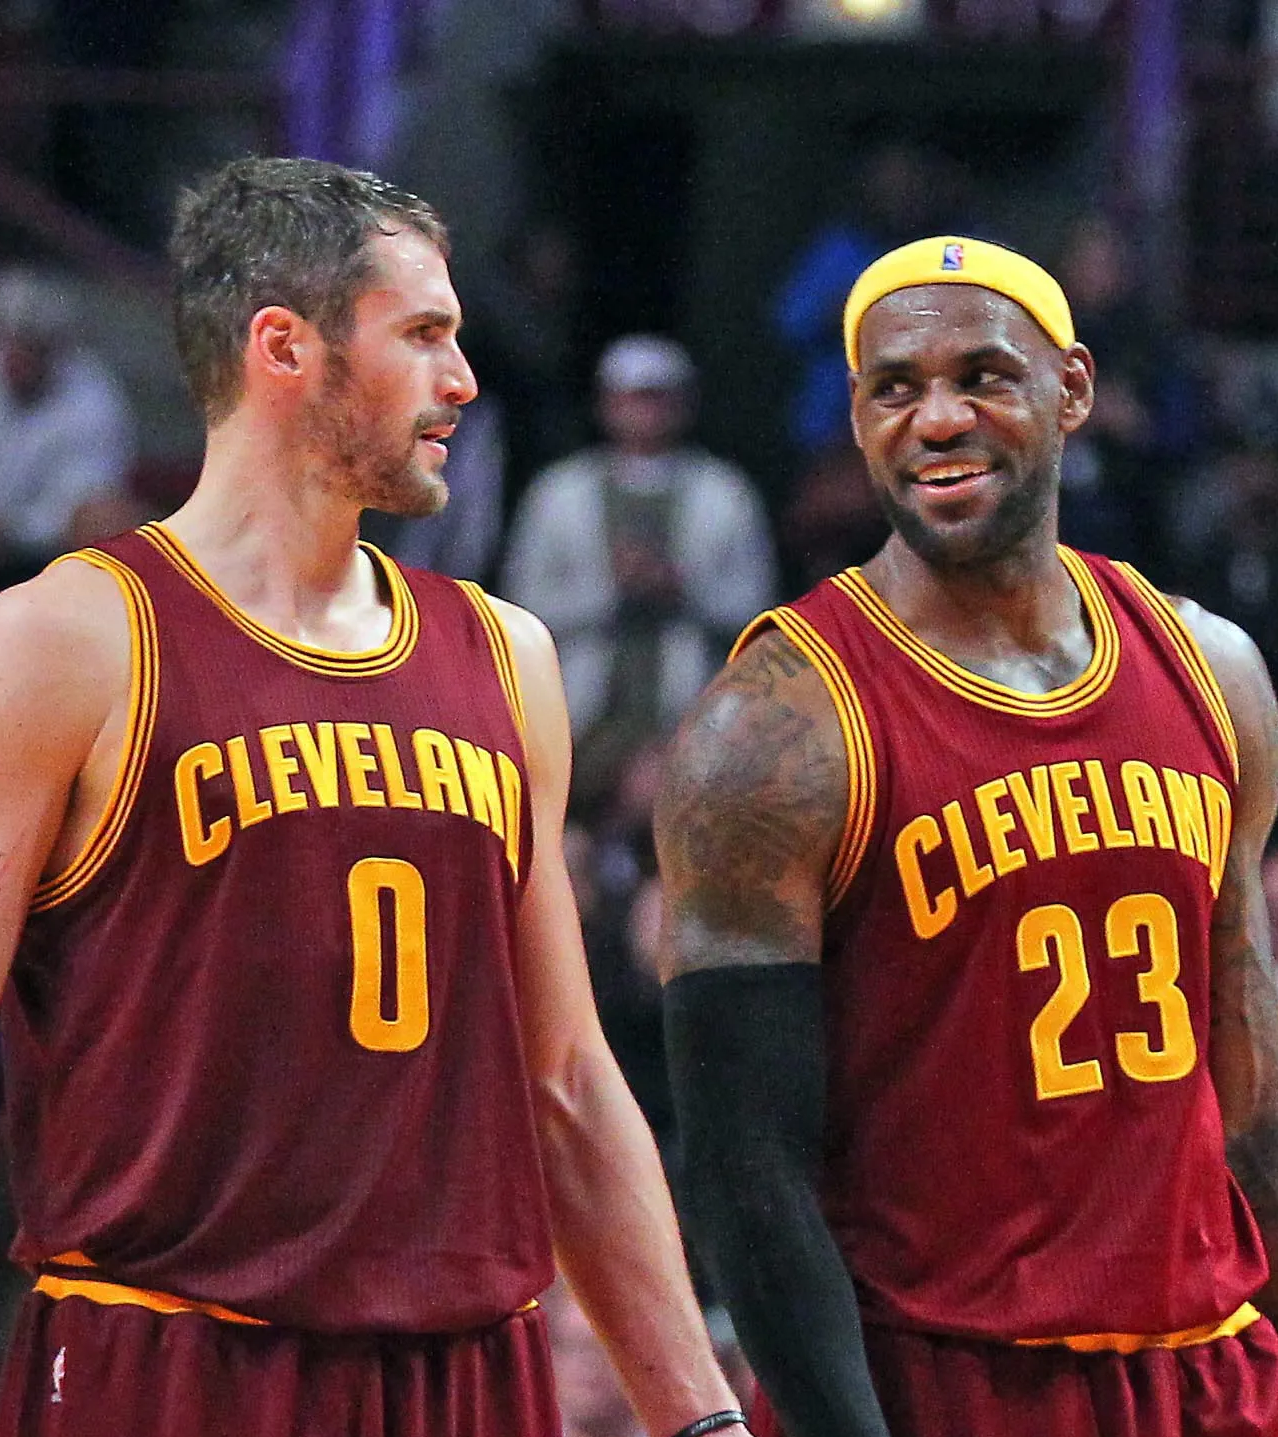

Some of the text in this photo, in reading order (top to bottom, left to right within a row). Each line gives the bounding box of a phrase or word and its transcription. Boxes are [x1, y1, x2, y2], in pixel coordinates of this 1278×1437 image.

[175, 721, 522, 883] CLEVELAND
[894, 760, 1232, 940] CLEVELAND
[348, 857, 429, 1052] 0
[1016, 892, 1197, 1101] 23
